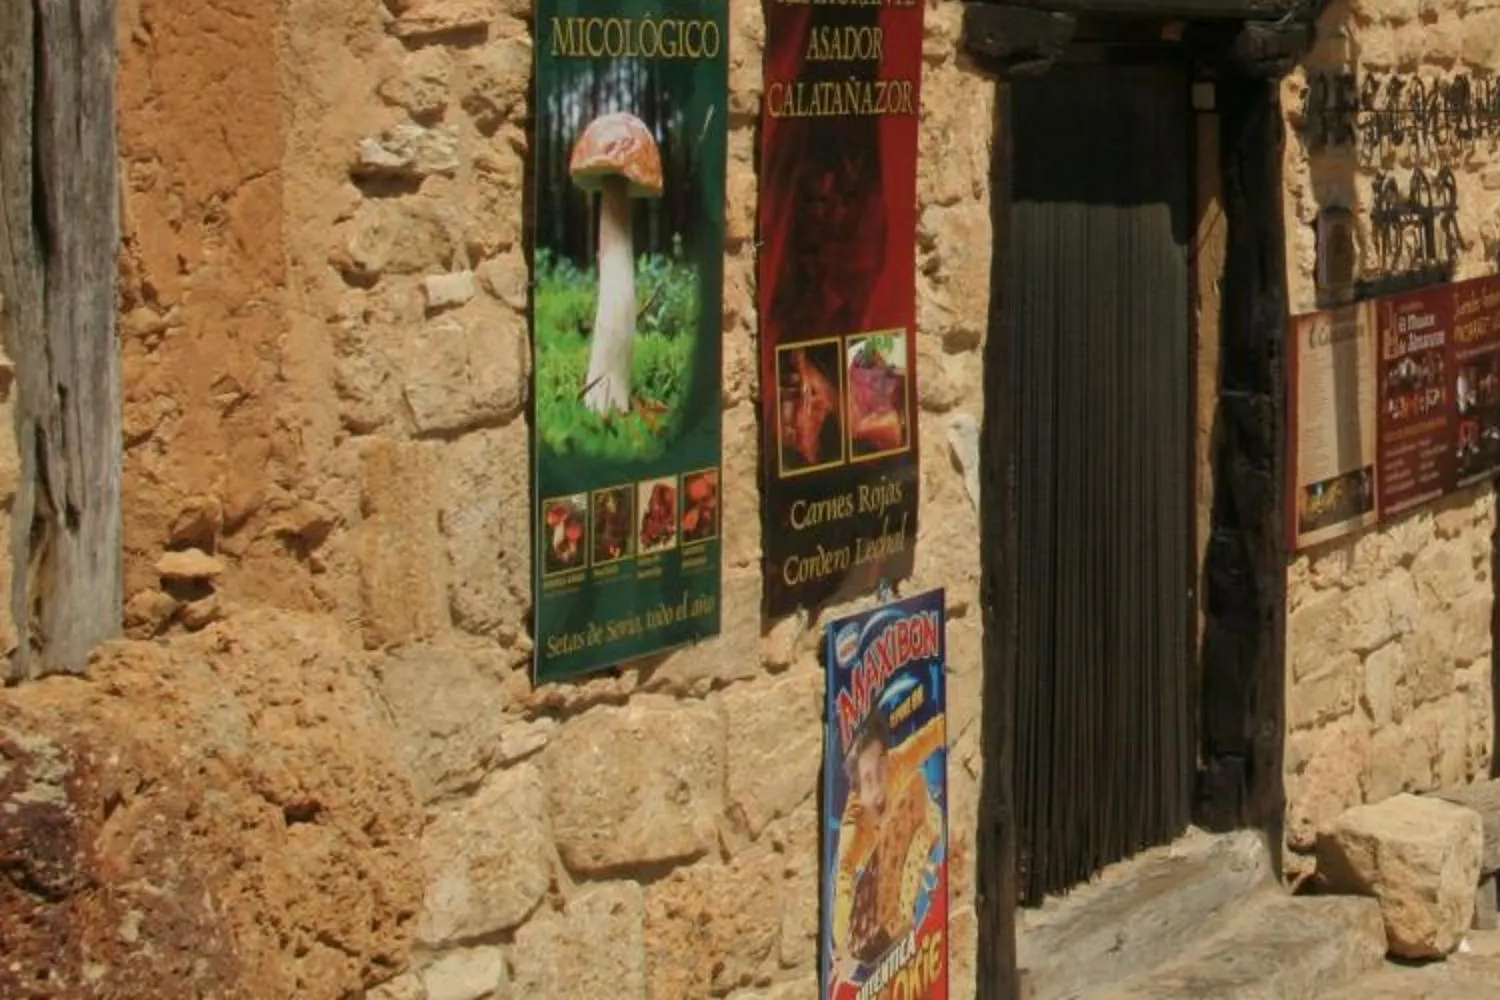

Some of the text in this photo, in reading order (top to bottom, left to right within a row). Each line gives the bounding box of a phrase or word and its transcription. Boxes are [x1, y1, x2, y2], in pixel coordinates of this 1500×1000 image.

[550, 12, 721, 60] MICOLÓGICO
[805, 25, 884, 61] ASADOR
[767, 75, 914, 119] CALATAÑAZOR
[789, 475, 904, 531] Carnes Rojas
[783, 543, 851, 586] Cordero
[836, 610, 939, 758] MAXIBON
